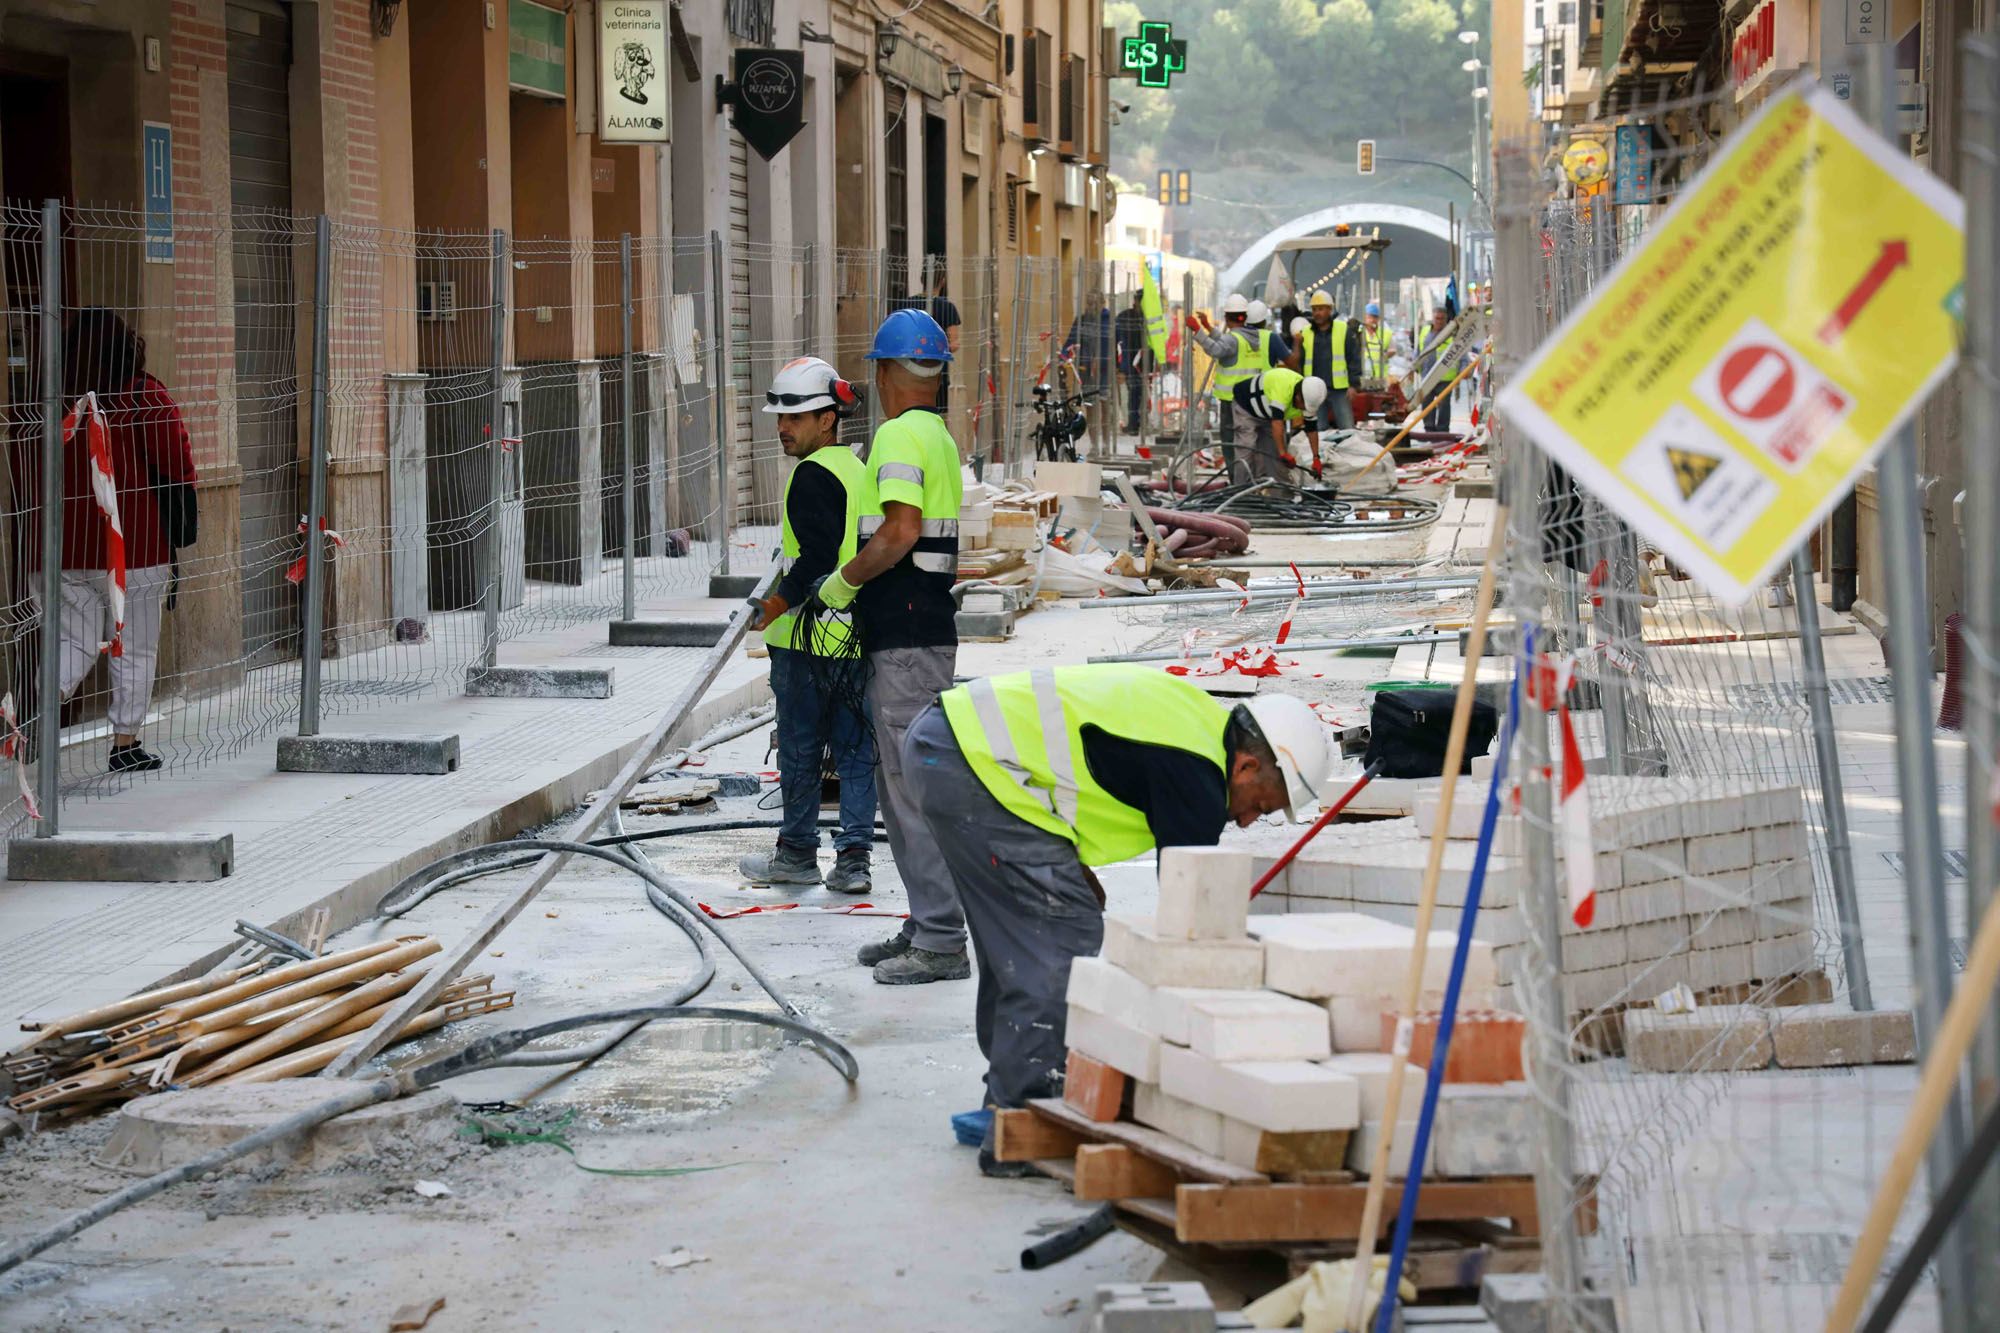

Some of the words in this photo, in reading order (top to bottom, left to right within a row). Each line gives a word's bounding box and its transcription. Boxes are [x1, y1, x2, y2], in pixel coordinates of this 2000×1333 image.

[605, 19, 661, 30] veterinaria
[614, 6, 651, 17] Clínica
[1859, 1, 1872, 34] PRO
[151, 138, 166, 199] H
[1620, 130, 1632, 203] CHANGE
[1692, 182, 1743, 235] POR
